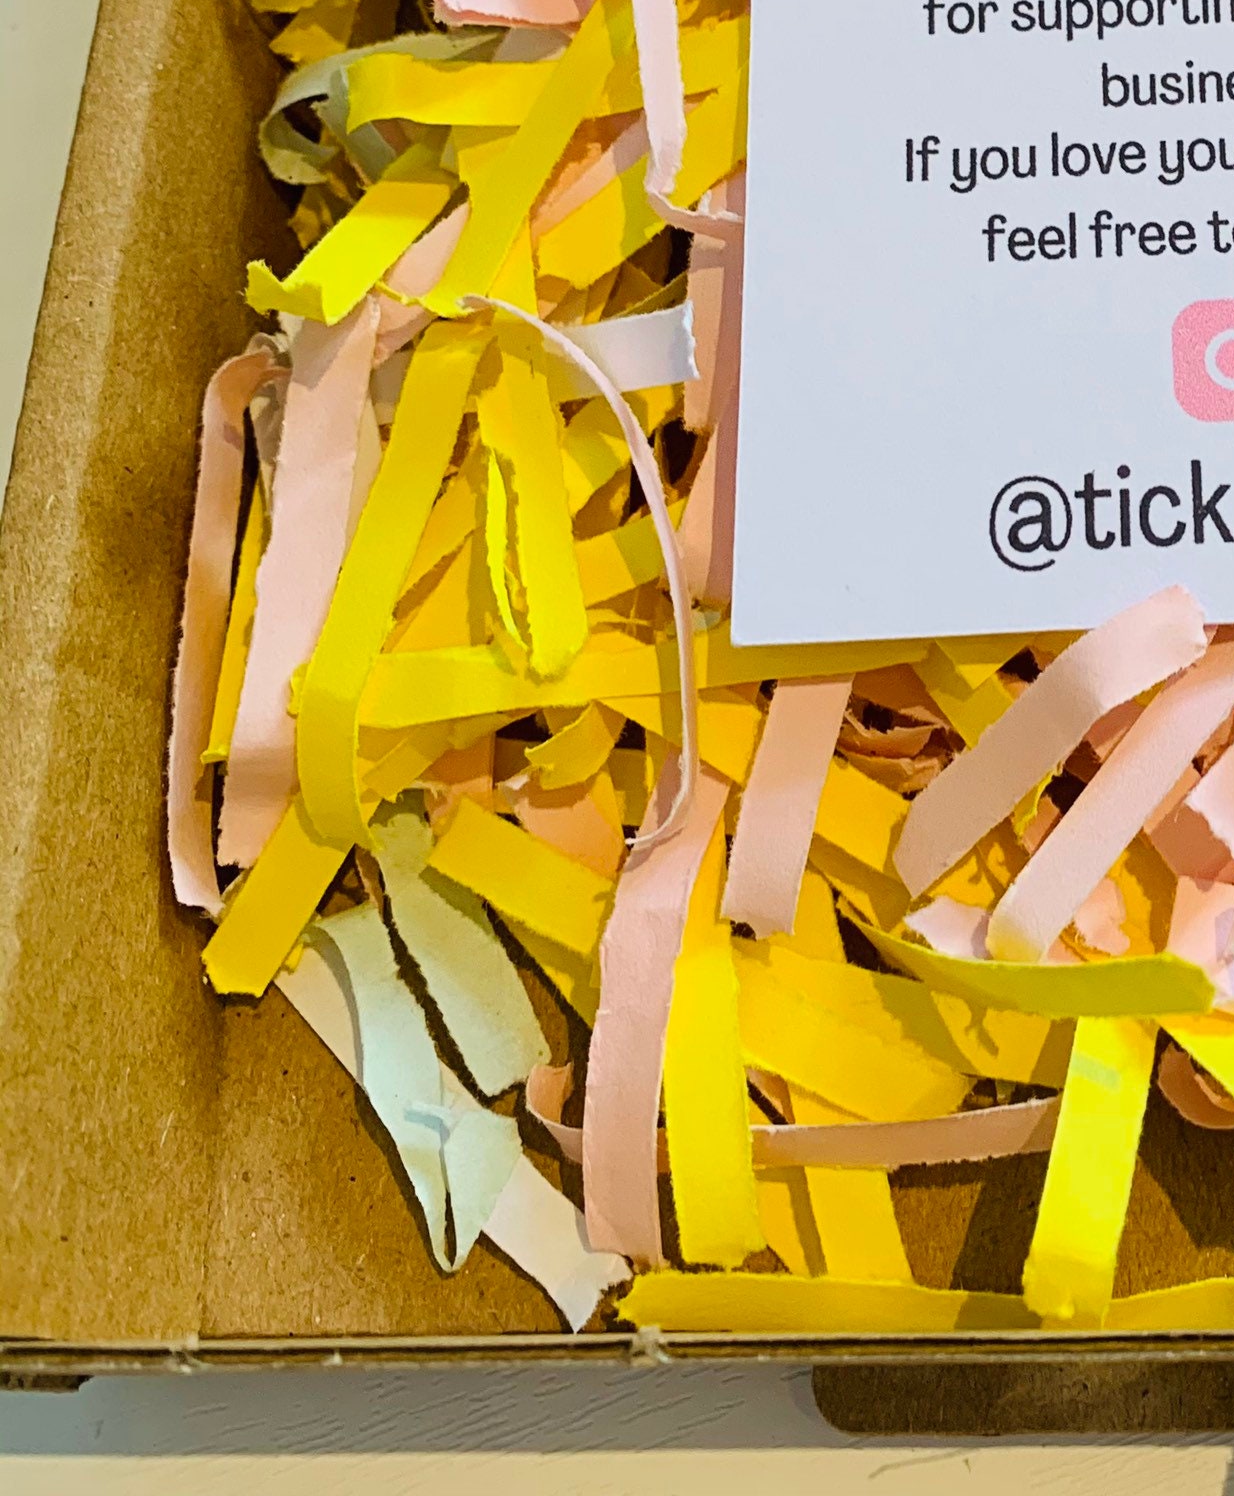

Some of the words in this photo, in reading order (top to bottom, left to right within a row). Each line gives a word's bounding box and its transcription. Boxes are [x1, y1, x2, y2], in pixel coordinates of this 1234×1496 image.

[906, 136, 940, 182] If
[950, 146, 1036, 193] you
[1051, 132, 1146, 176] love
[982, 212, 1077, 262] feel
[1088, 210, 1197, 258] free
